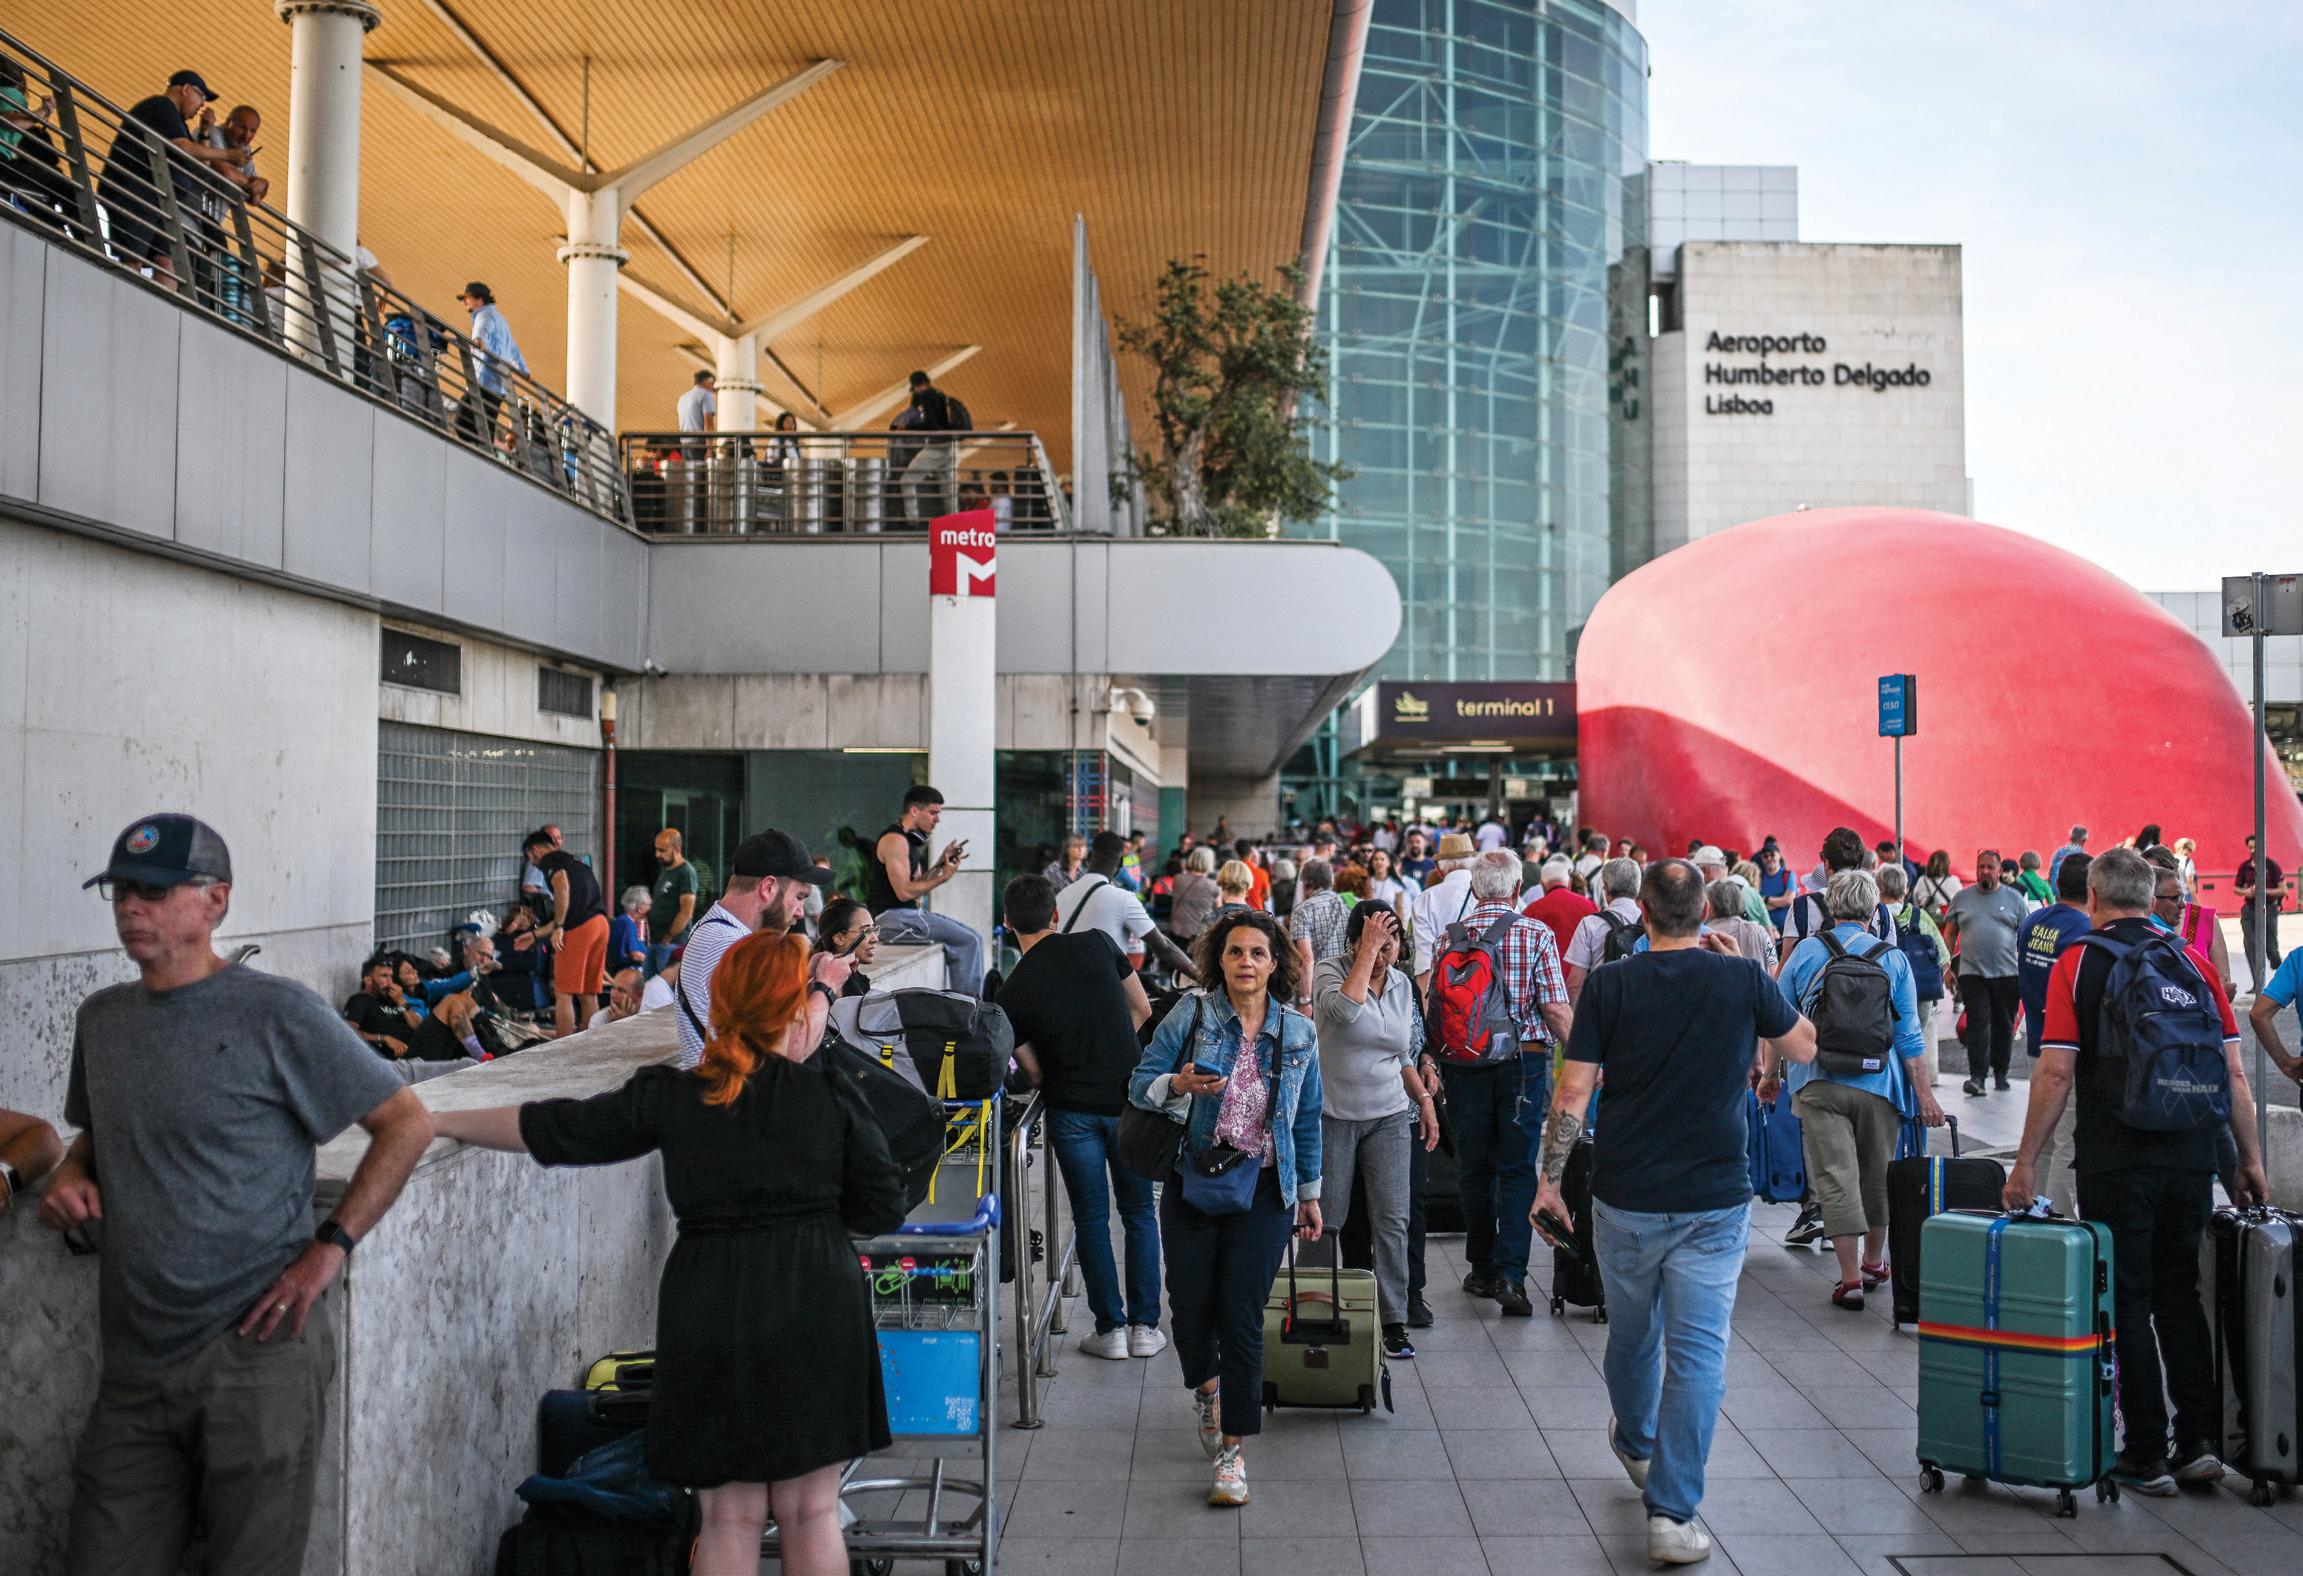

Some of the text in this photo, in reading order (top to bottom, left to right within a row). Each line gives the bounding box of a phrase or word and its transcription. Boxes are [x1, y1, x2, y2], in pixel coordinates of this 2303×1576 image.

[1705, 330, 1826, 357] Aeroporto
[1705, 362, 1931, 392] Humberto Delgado
[1706, 393, 1773, 415] Lisboa
[940, 528, 994, 548] metro
[1456, 698, 1554, 716] terminal 1
[2031, 925, 2059, 941] SALSA
[2028, 938, 2055, 953] JEANS
[2191, 1084, 2219, 1094] HAIX
